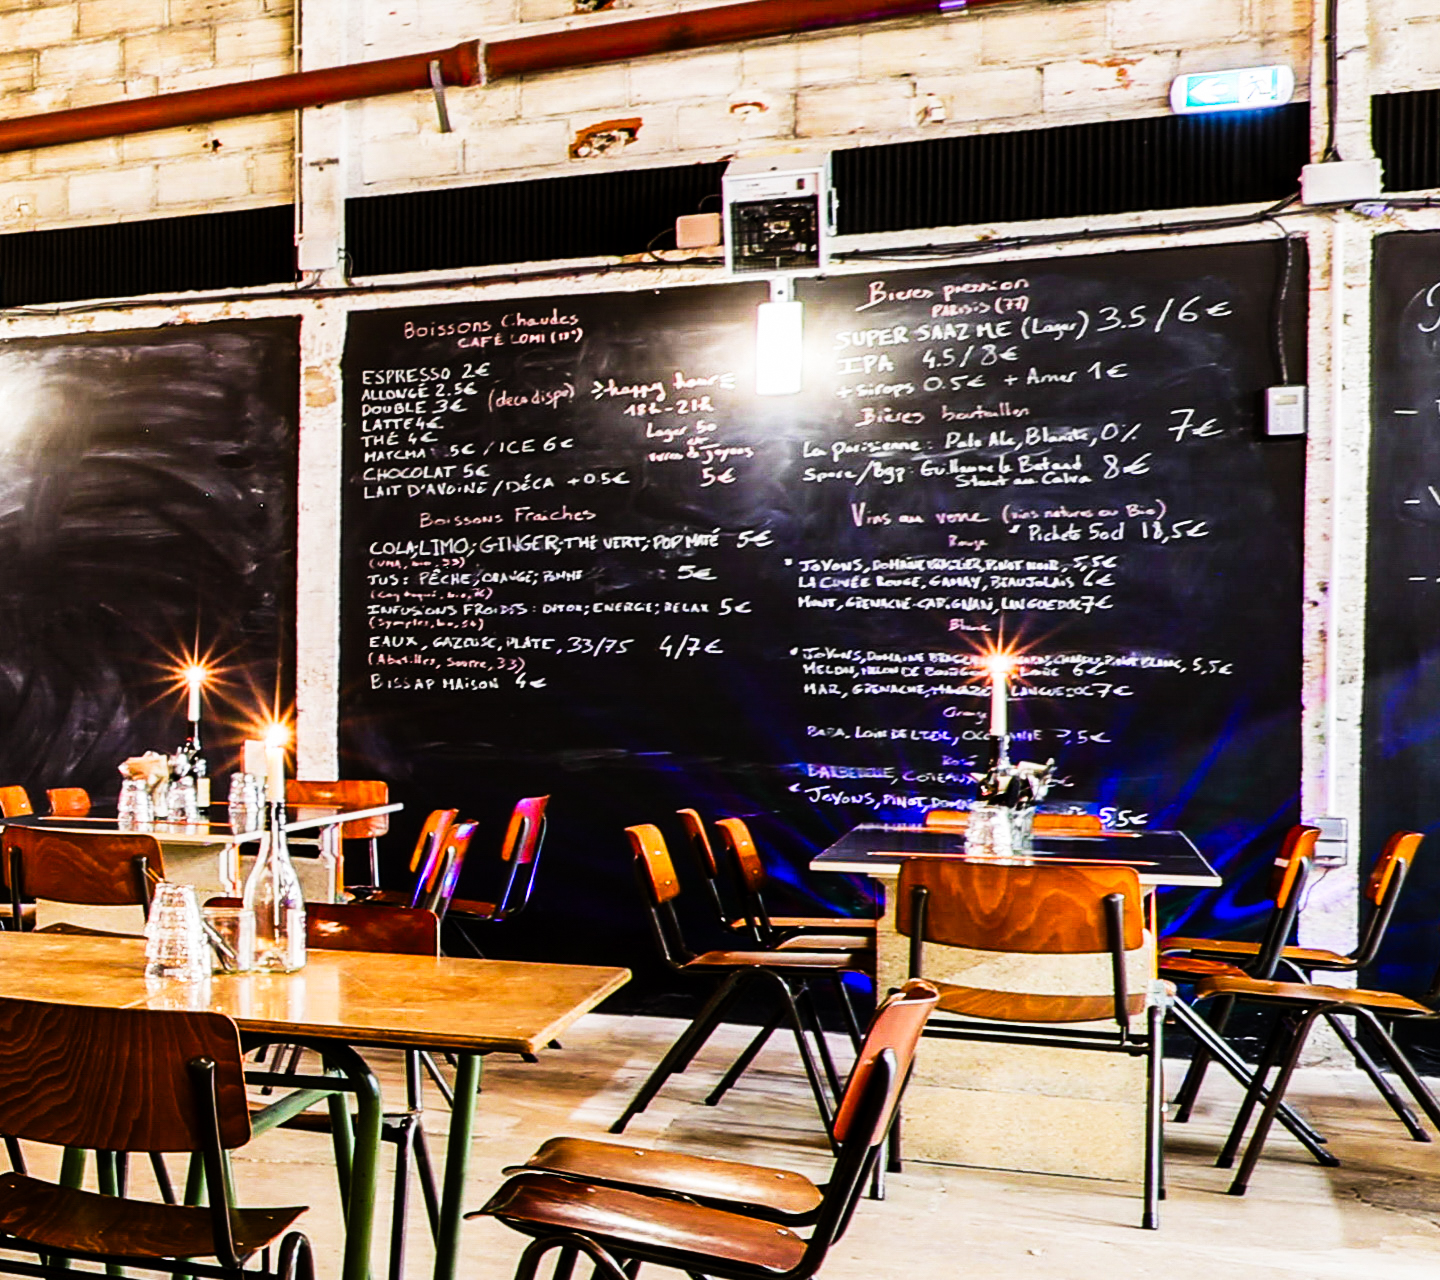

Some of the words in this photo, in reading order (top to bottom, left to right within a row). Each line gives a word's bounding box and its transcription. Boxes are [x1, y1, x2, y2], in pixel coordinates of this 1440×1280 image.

[943, 279, 1029, 301] pression
[404, 321, 492, 339] Boissons
[501, 308, 579, 327] Chaudes
[833, 326, 909, 350] SUPER
[916, 325, 969, 342] SAAZ
[1021, 310, 1090, 341] (Lager)
[511, 332, 546, 344] LOMI
[362, 367, 452, 385] ESPRESSO
[461, 362, 491, 379] 2€
[837, 354, 894, 375] IPA
[923, 374, 987, 392] 0.5€
[1087, 361, 1128, 380] 1€
[436, 381, 478, 398] 2.5€
[604, 379, 666, 402] happy
[362, 400, 427, 416] DOUBLE
[432, 398, 468, 414] 3€
[362, 419, 411, 432] LATTE
[415, 416, 444, 430] 4€
[646, 422, 688, 442] Lager
[945, 432, 982, 449] Pale
[1168, 408, 1224, 442] 7€
[361, 432, 399, 447] THÉ
[408, 431, 438, 443] 4€
[499, 439, 536, 454] ICE
[543, 436, 574, 452] 6€
[363, 465, 457, 481] CHOCOLAT
[463, 464, 490, 478] 5€
[1103, 453, 1152, 479] 8€
[700, 467, 736, 487] 5€
[364, 484, 401, 499] LAIT
[420, 512, 504, 528] Boissons
[851, 502, 892, 526] Vins
[1126, 499, 1166, 520] Bio)
[736, 530, 774, 548] 5€
[1142, 520, 1210, 544] 18,5€
[678, 565, 717, 580] 5€
[1073, 555, 1118, 572] 5,5€
[799, 576, 816, 588] LA
[1083, 570, 1116, 587] 6€
[718, 598, 752, 615] 5€
[1081, 595, 1113, 613] 7€
[567, 637, 634, 656] 33/75
[659, 635, 724, 660] 4/7€
[1192, 657, 1233, 675] 5,5€
[515, 672, 547, 689] 4€
[1092, 683, 1134, 699] 7€
